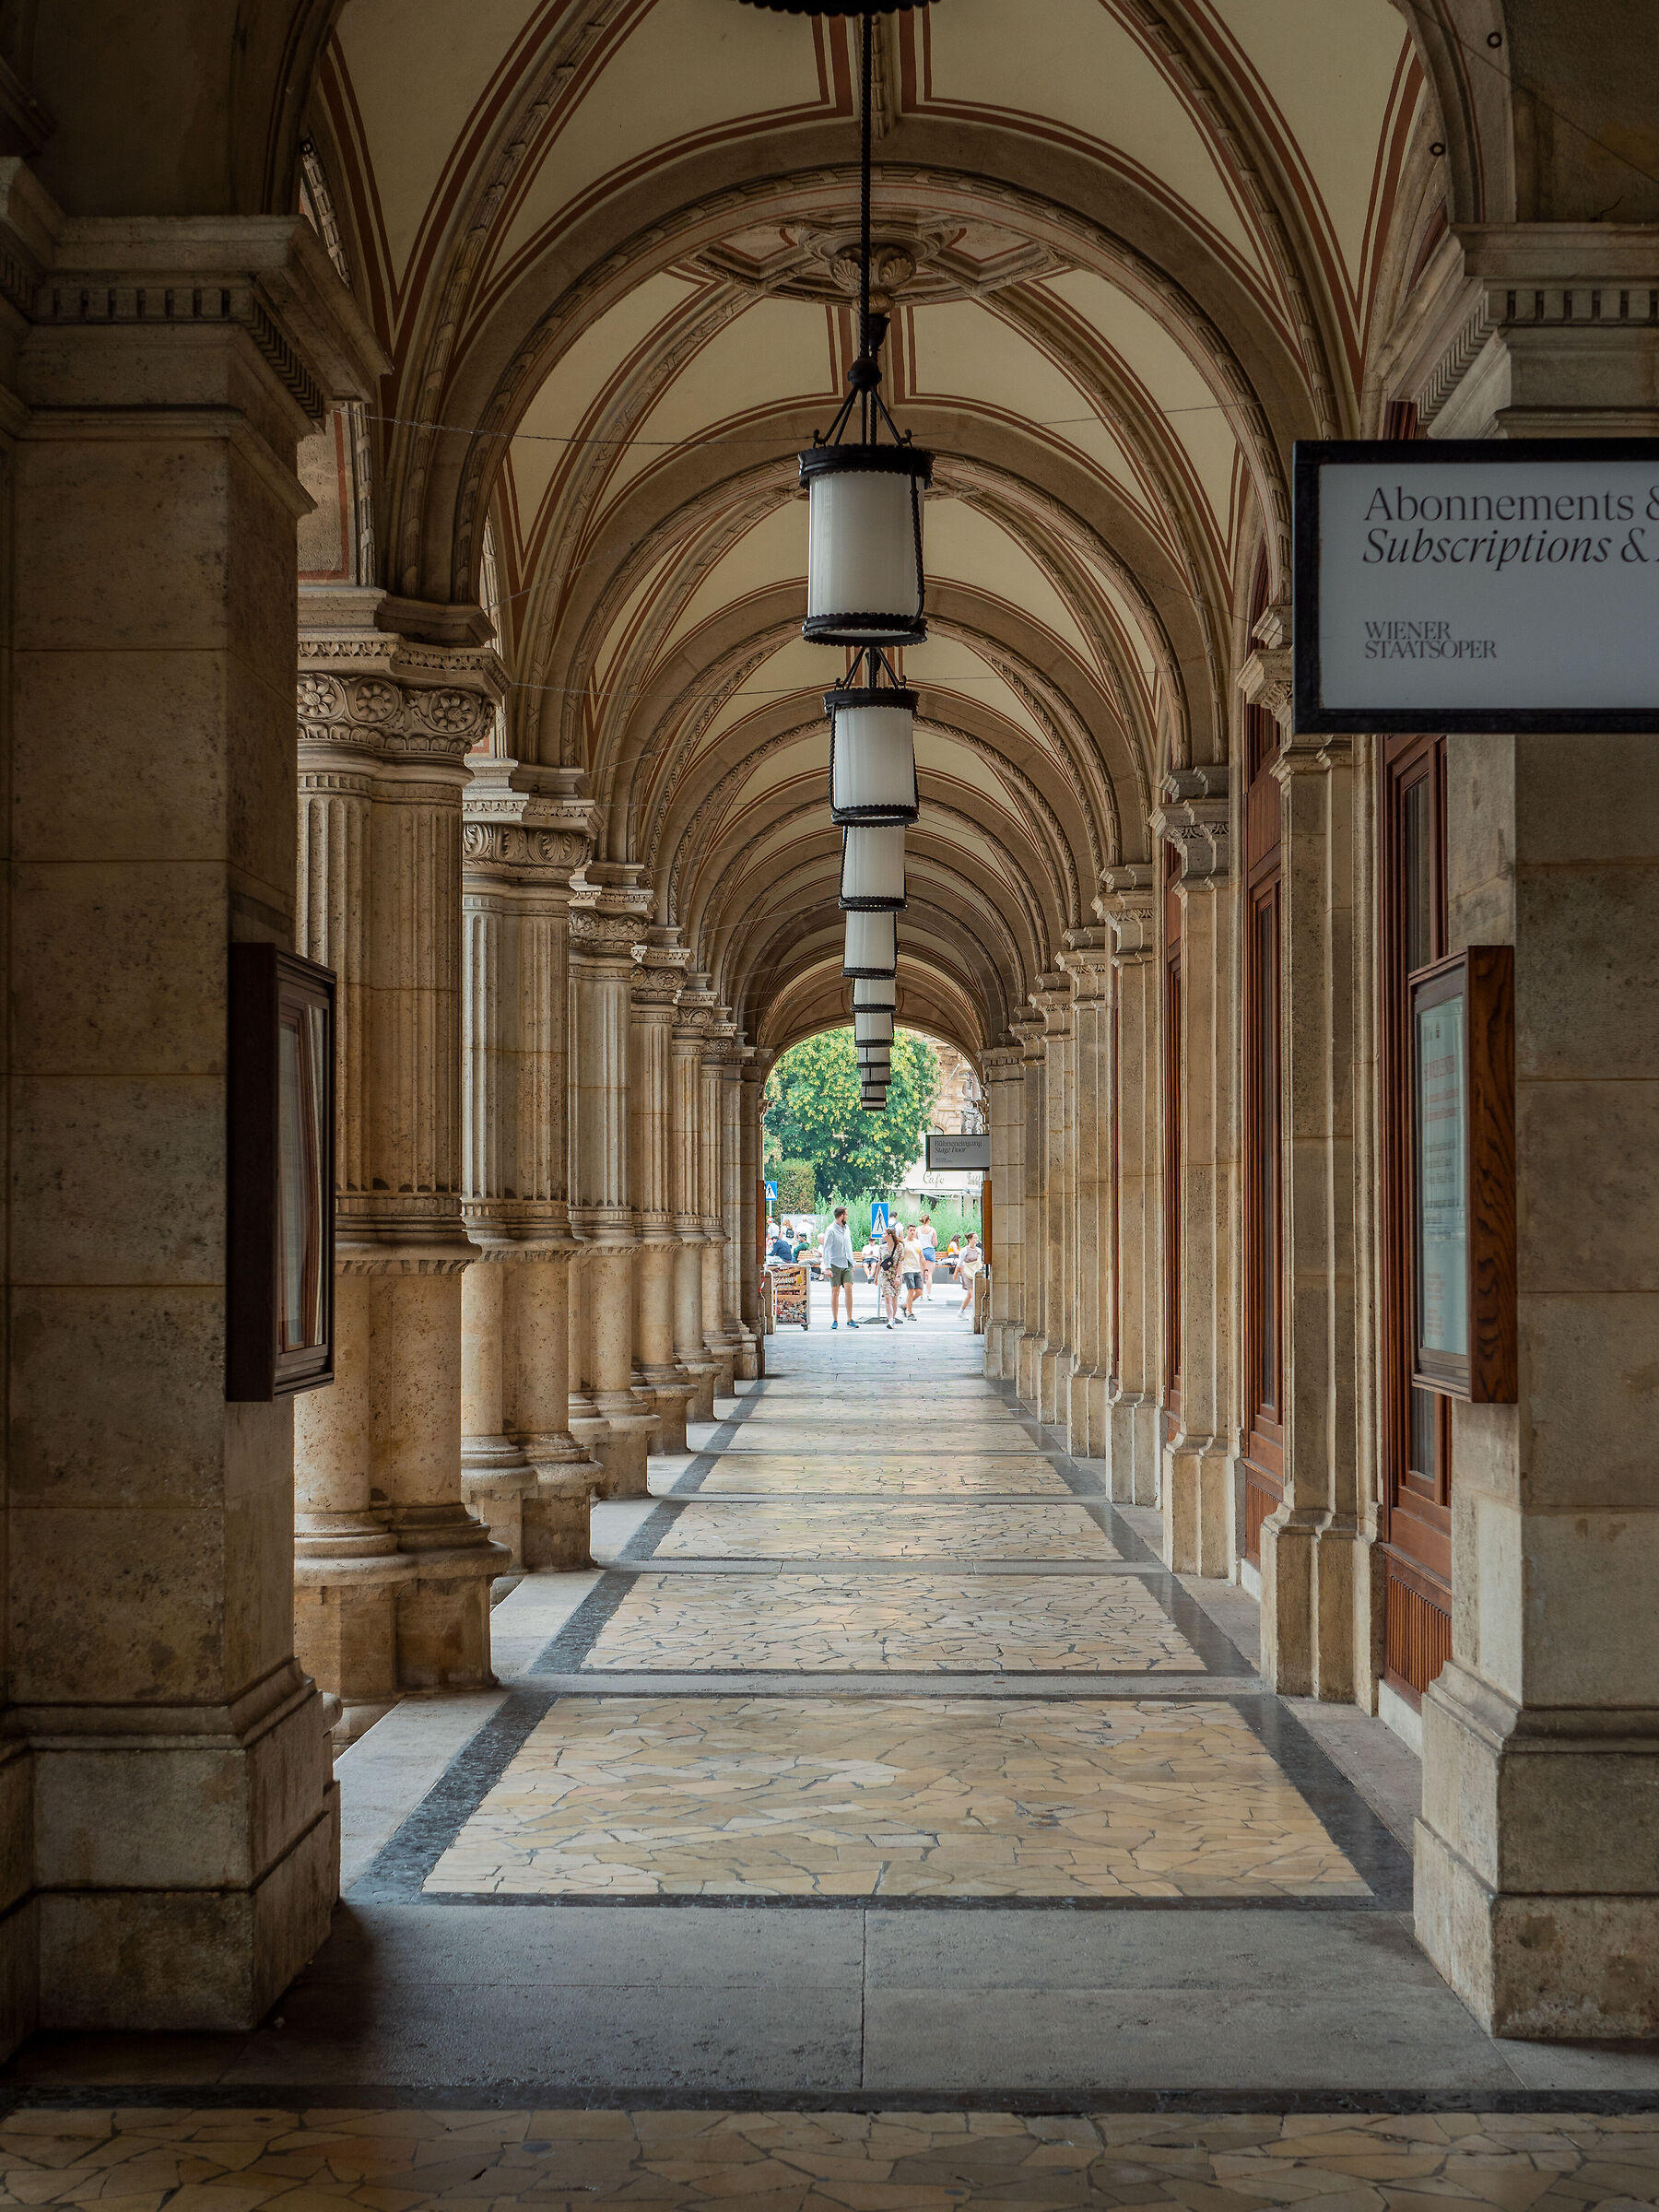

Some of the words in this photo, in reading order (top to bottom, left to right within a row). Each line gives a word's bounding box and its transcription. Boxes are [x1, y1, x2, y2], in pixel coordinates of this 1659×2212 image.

[1363, 486, 1634, 522] Abonnements
[1362, 527, 1613, 571] Subscriptions
[1621, 526, 1649, 563] &
[1364, 621, 1452, 640] WIENER
[1364, 641, 1498, 659] STAATSOPER
